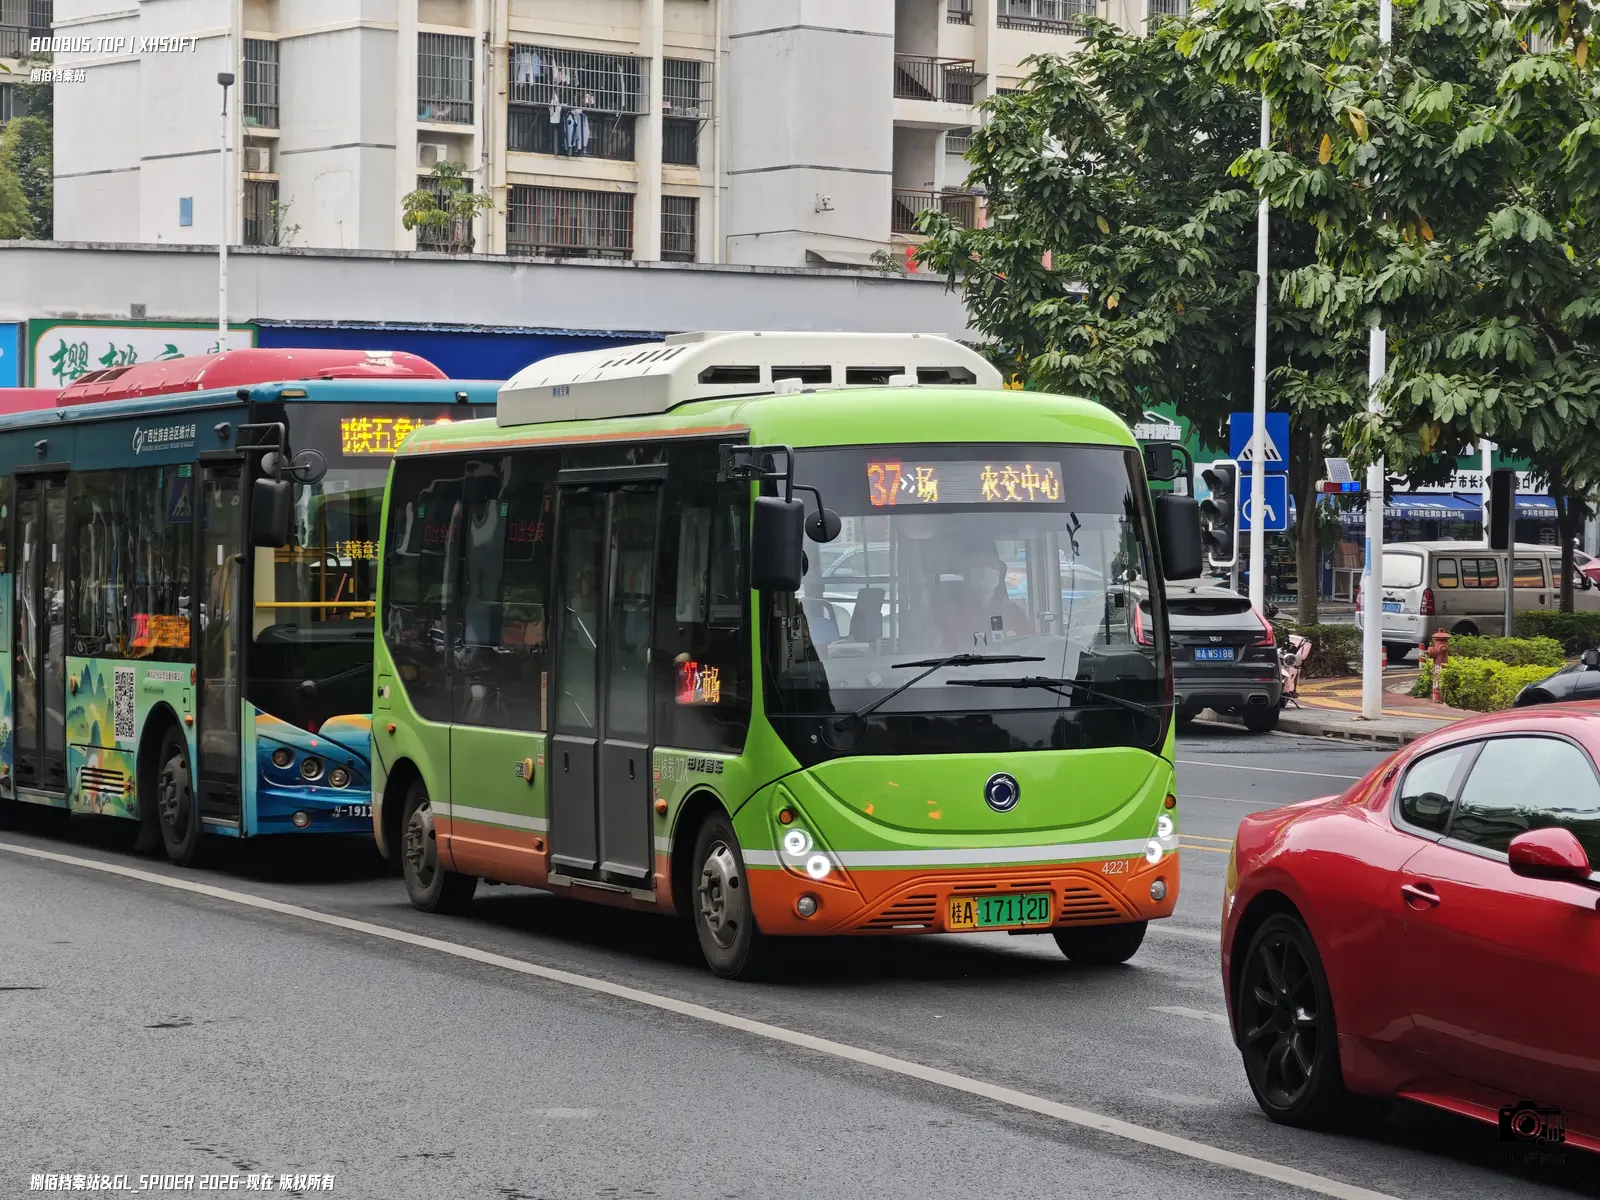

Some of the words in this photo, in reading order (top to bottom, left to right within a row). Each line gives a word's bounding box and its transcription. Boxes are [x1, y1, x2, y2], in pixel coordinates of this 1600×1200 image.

[866, 462, 902, 507] 37
[1101, 860, 1129, 875] 4221
[951, 896, 1050, 925] 桂A17112D
